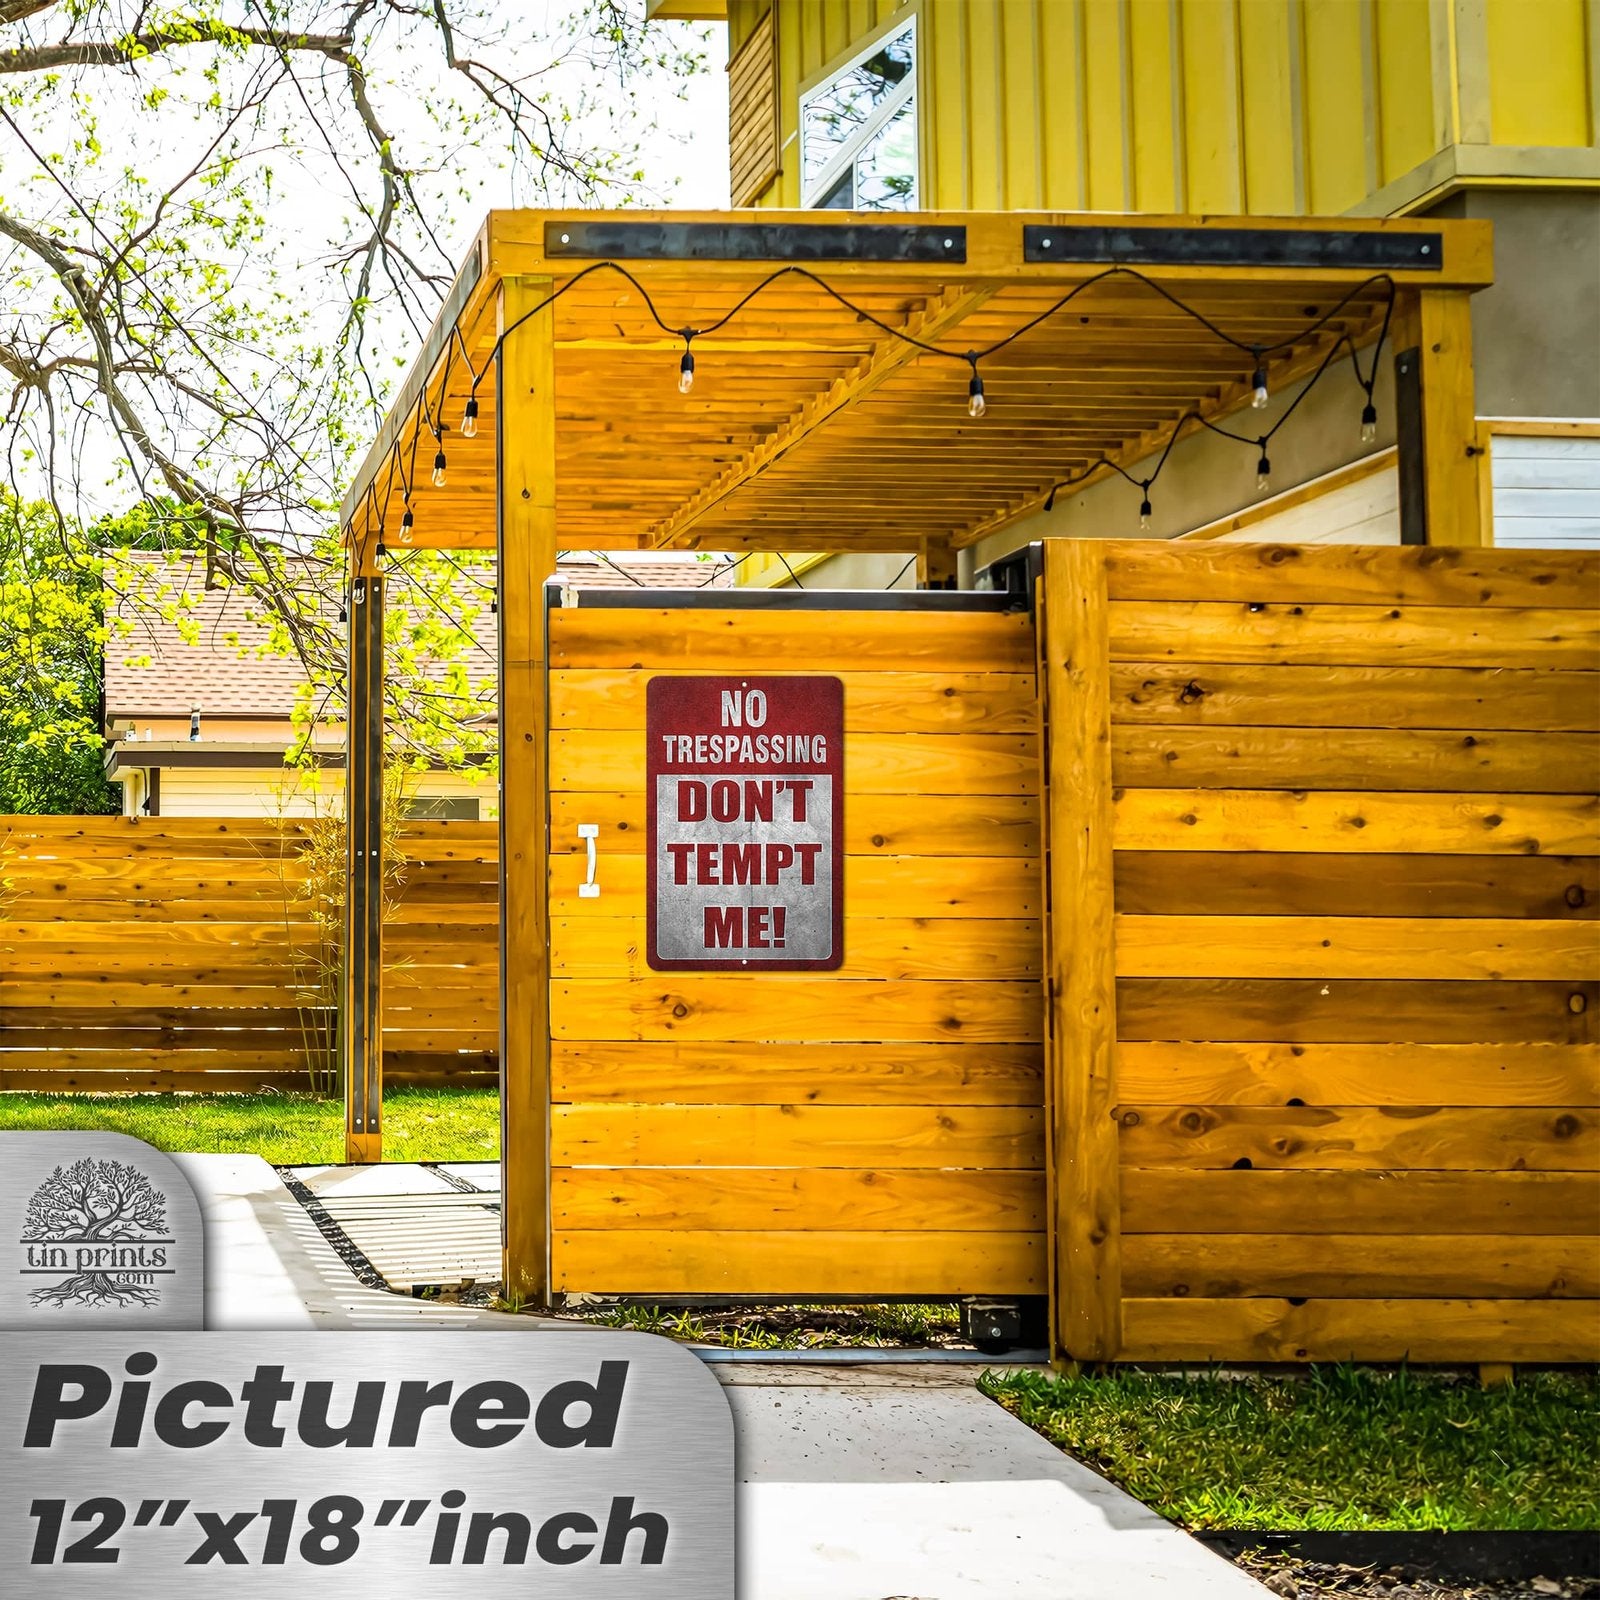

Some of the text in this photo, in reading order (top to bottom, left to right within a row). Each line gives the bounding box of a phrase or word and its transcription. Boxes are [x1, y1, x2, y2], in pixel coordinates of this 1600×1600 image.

[721, 689, 768, 728] NO
[663, 734, 827, 764] TRESPASSING
[677, 779, 814, 823] DON'T
[666, 843, 823, 886] TEMPT
[703, 906, 787, 949] ME!
